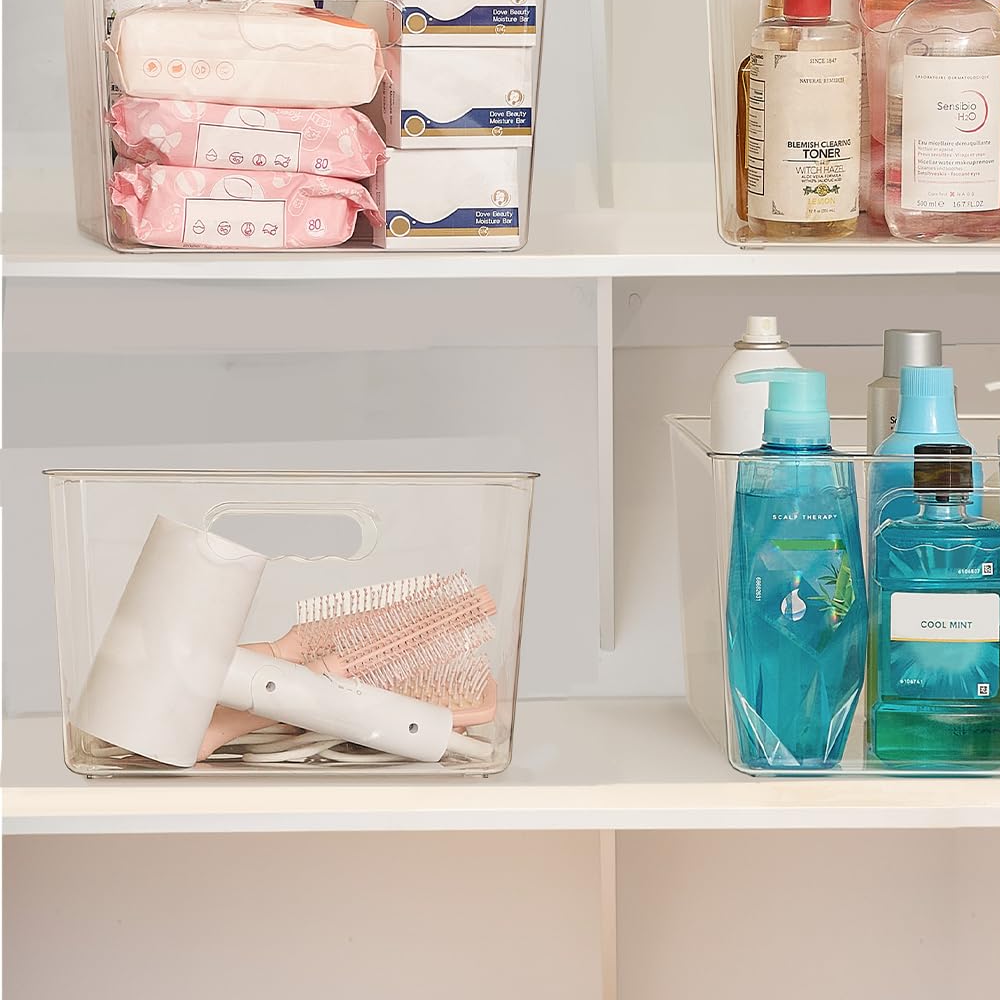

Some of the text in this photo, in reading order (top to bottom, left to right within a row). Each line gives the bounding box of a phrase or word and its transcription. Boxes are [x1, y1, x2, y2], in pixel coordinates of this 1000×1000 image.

[937, 101, 977, 111] Sensibio
[821, 139, 851, 148] CLEARING
[802, 148, 841, 159] TONER
[314, 158, 329, 170] 80
[795, 165, 846, 174] WITCH HAZEL
[308, 218, 322, 231] 80
[920, 620, 973, 629] COOL MINT
